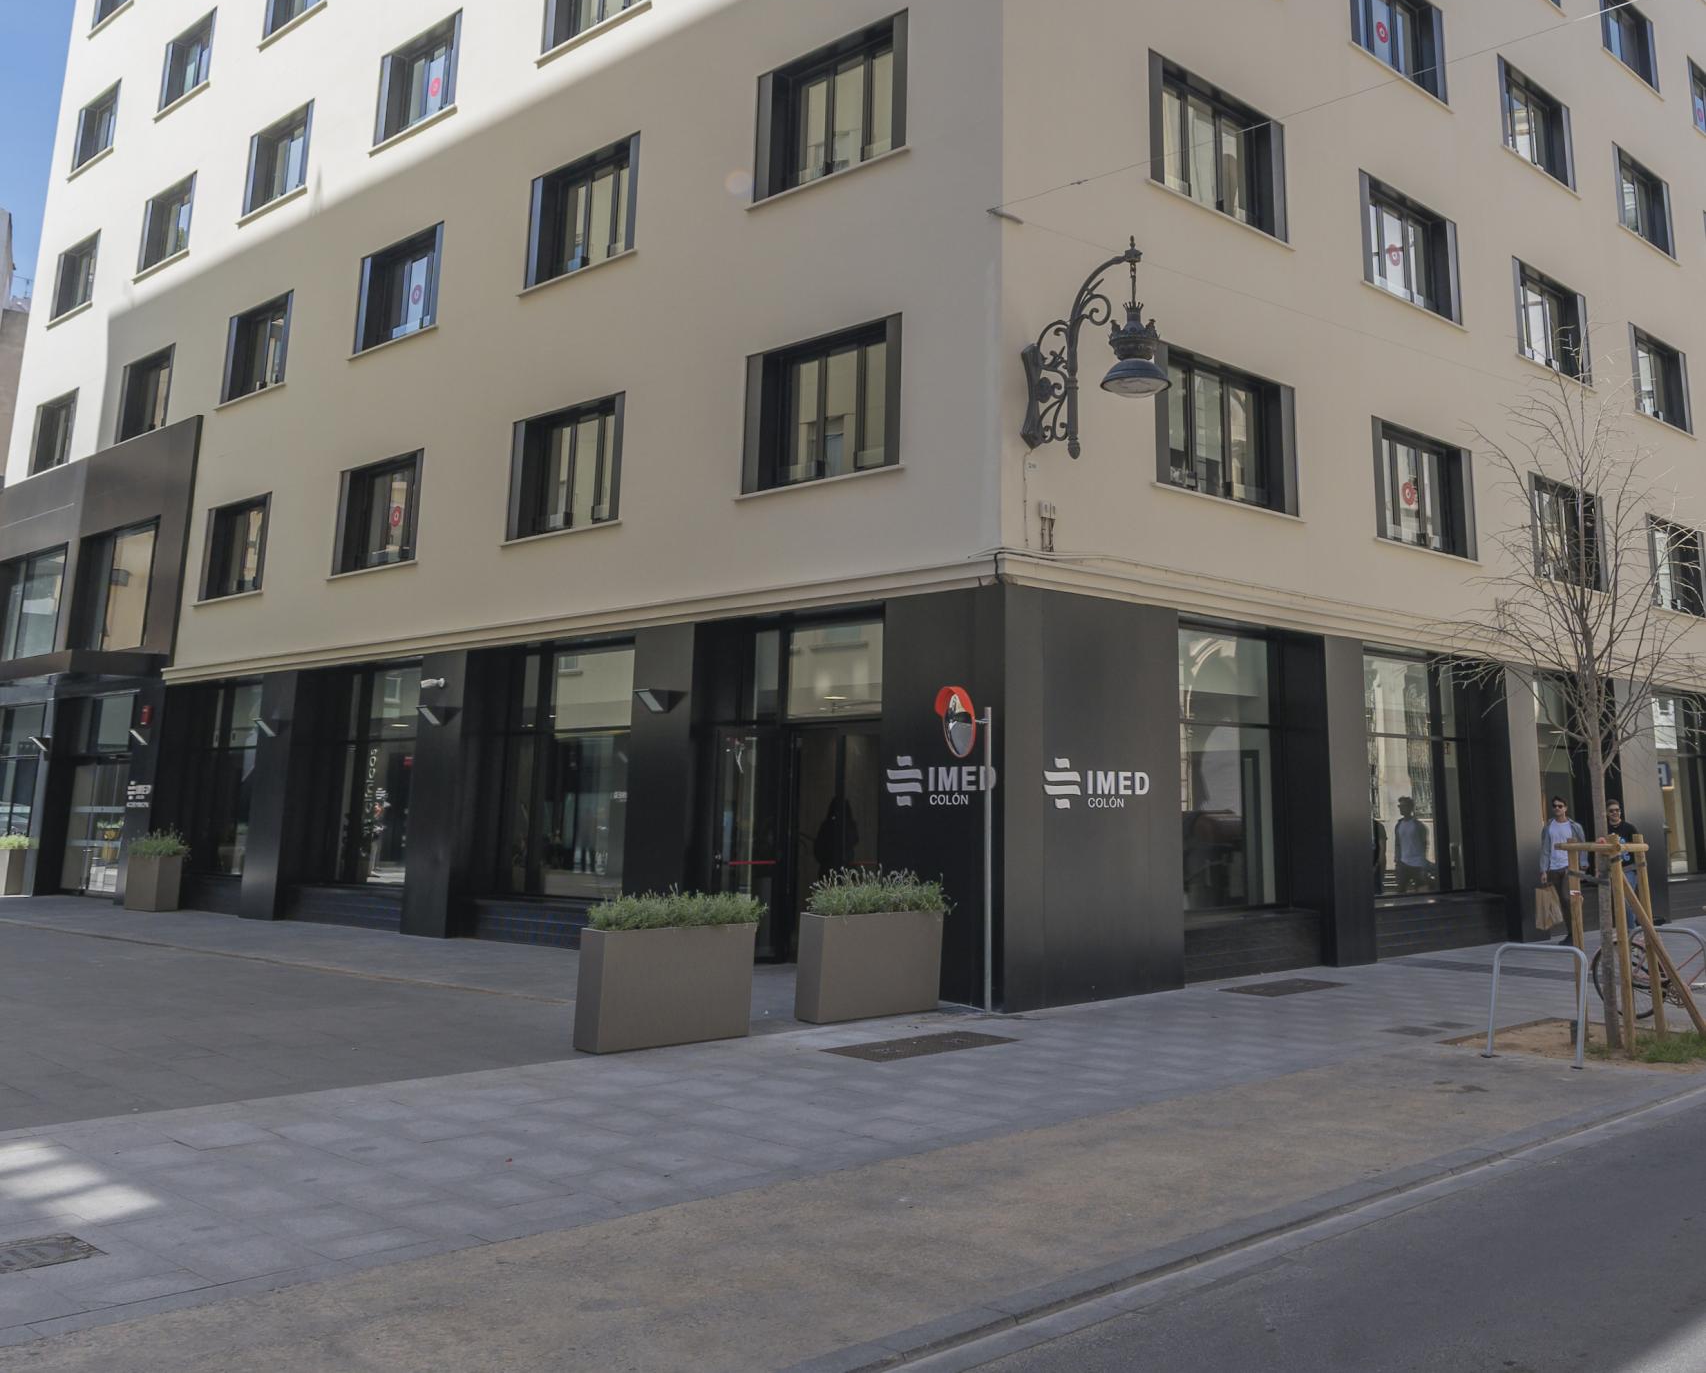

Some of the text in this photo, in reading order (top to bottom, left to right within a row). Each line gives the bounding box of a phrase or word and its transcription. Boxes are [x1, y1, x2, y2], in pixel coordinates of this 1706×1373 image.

[928, 766, 997, 792] IMED
[1087, 770, 1150, 795] IMED
[929, 792, 969, 805] COLÓN
[1087, 796, 1125, 809] COLÓN
